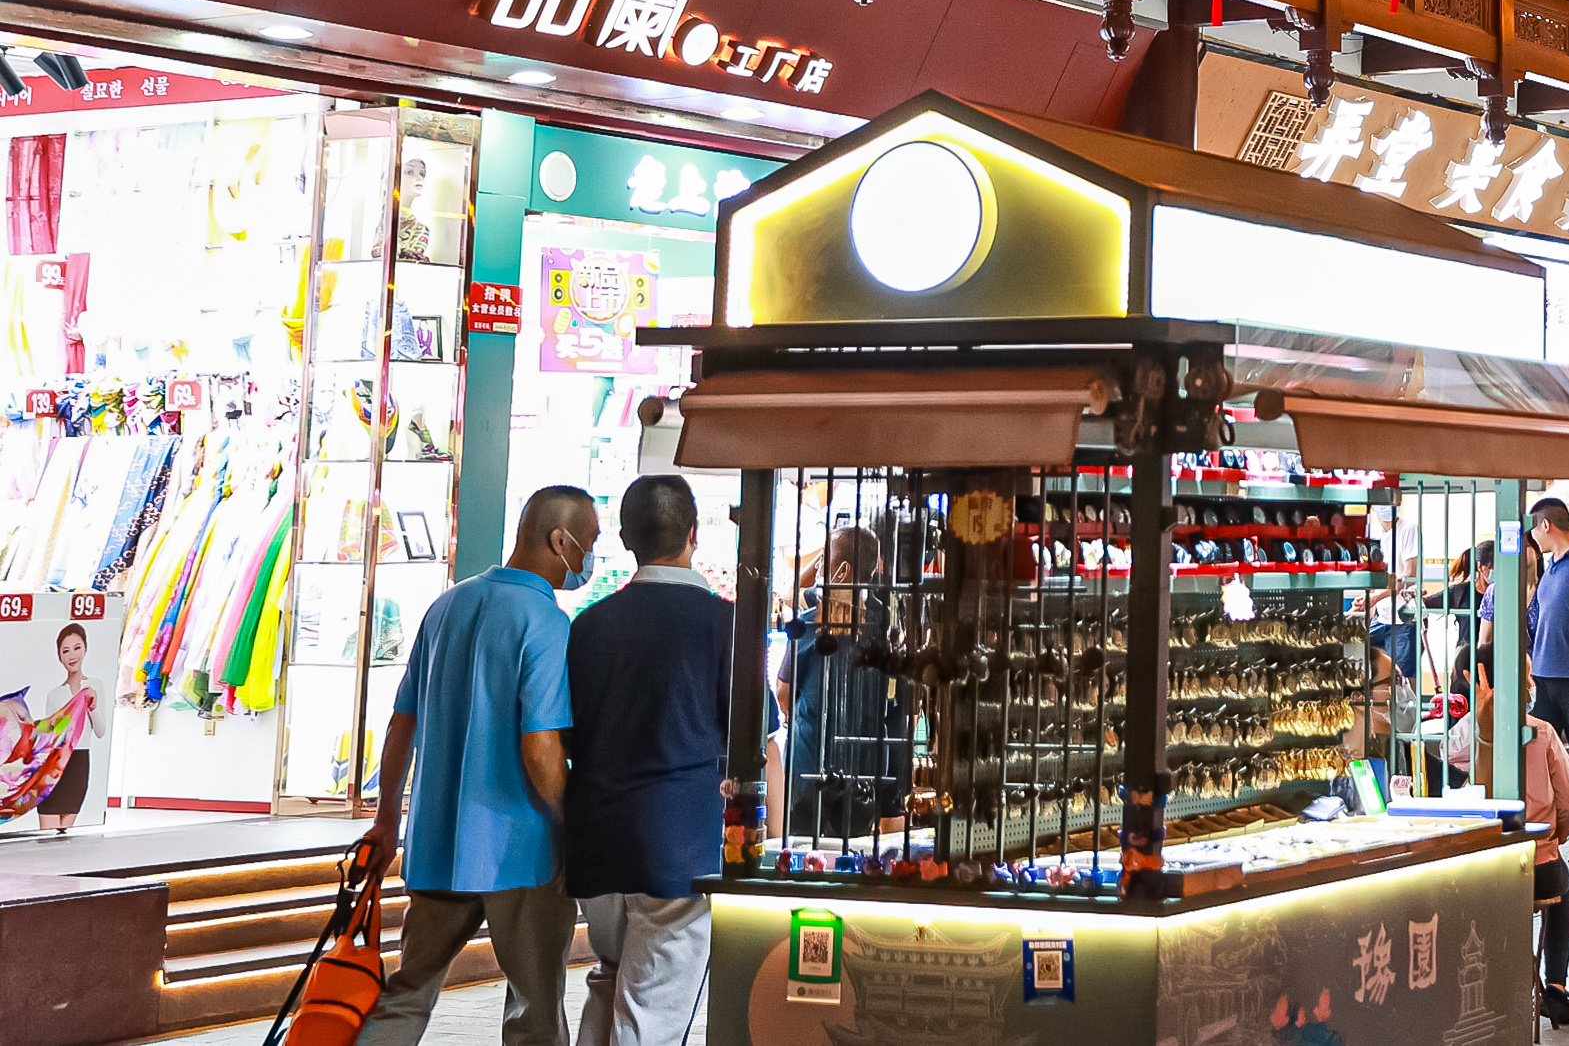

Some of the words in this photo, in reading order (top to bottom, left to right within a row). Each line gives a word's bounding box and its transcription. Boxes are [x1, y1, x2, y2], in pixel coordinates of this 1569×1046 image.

[725, 45, 834, 95] 工厂店
[140, 76, 170, 97] 선물
[578, 266, 621, 290] 新品
[484, 285, 511, 302] 招聘
[0, 596, 29, 618] 69元
[74, 595, 102, 616] 99元
